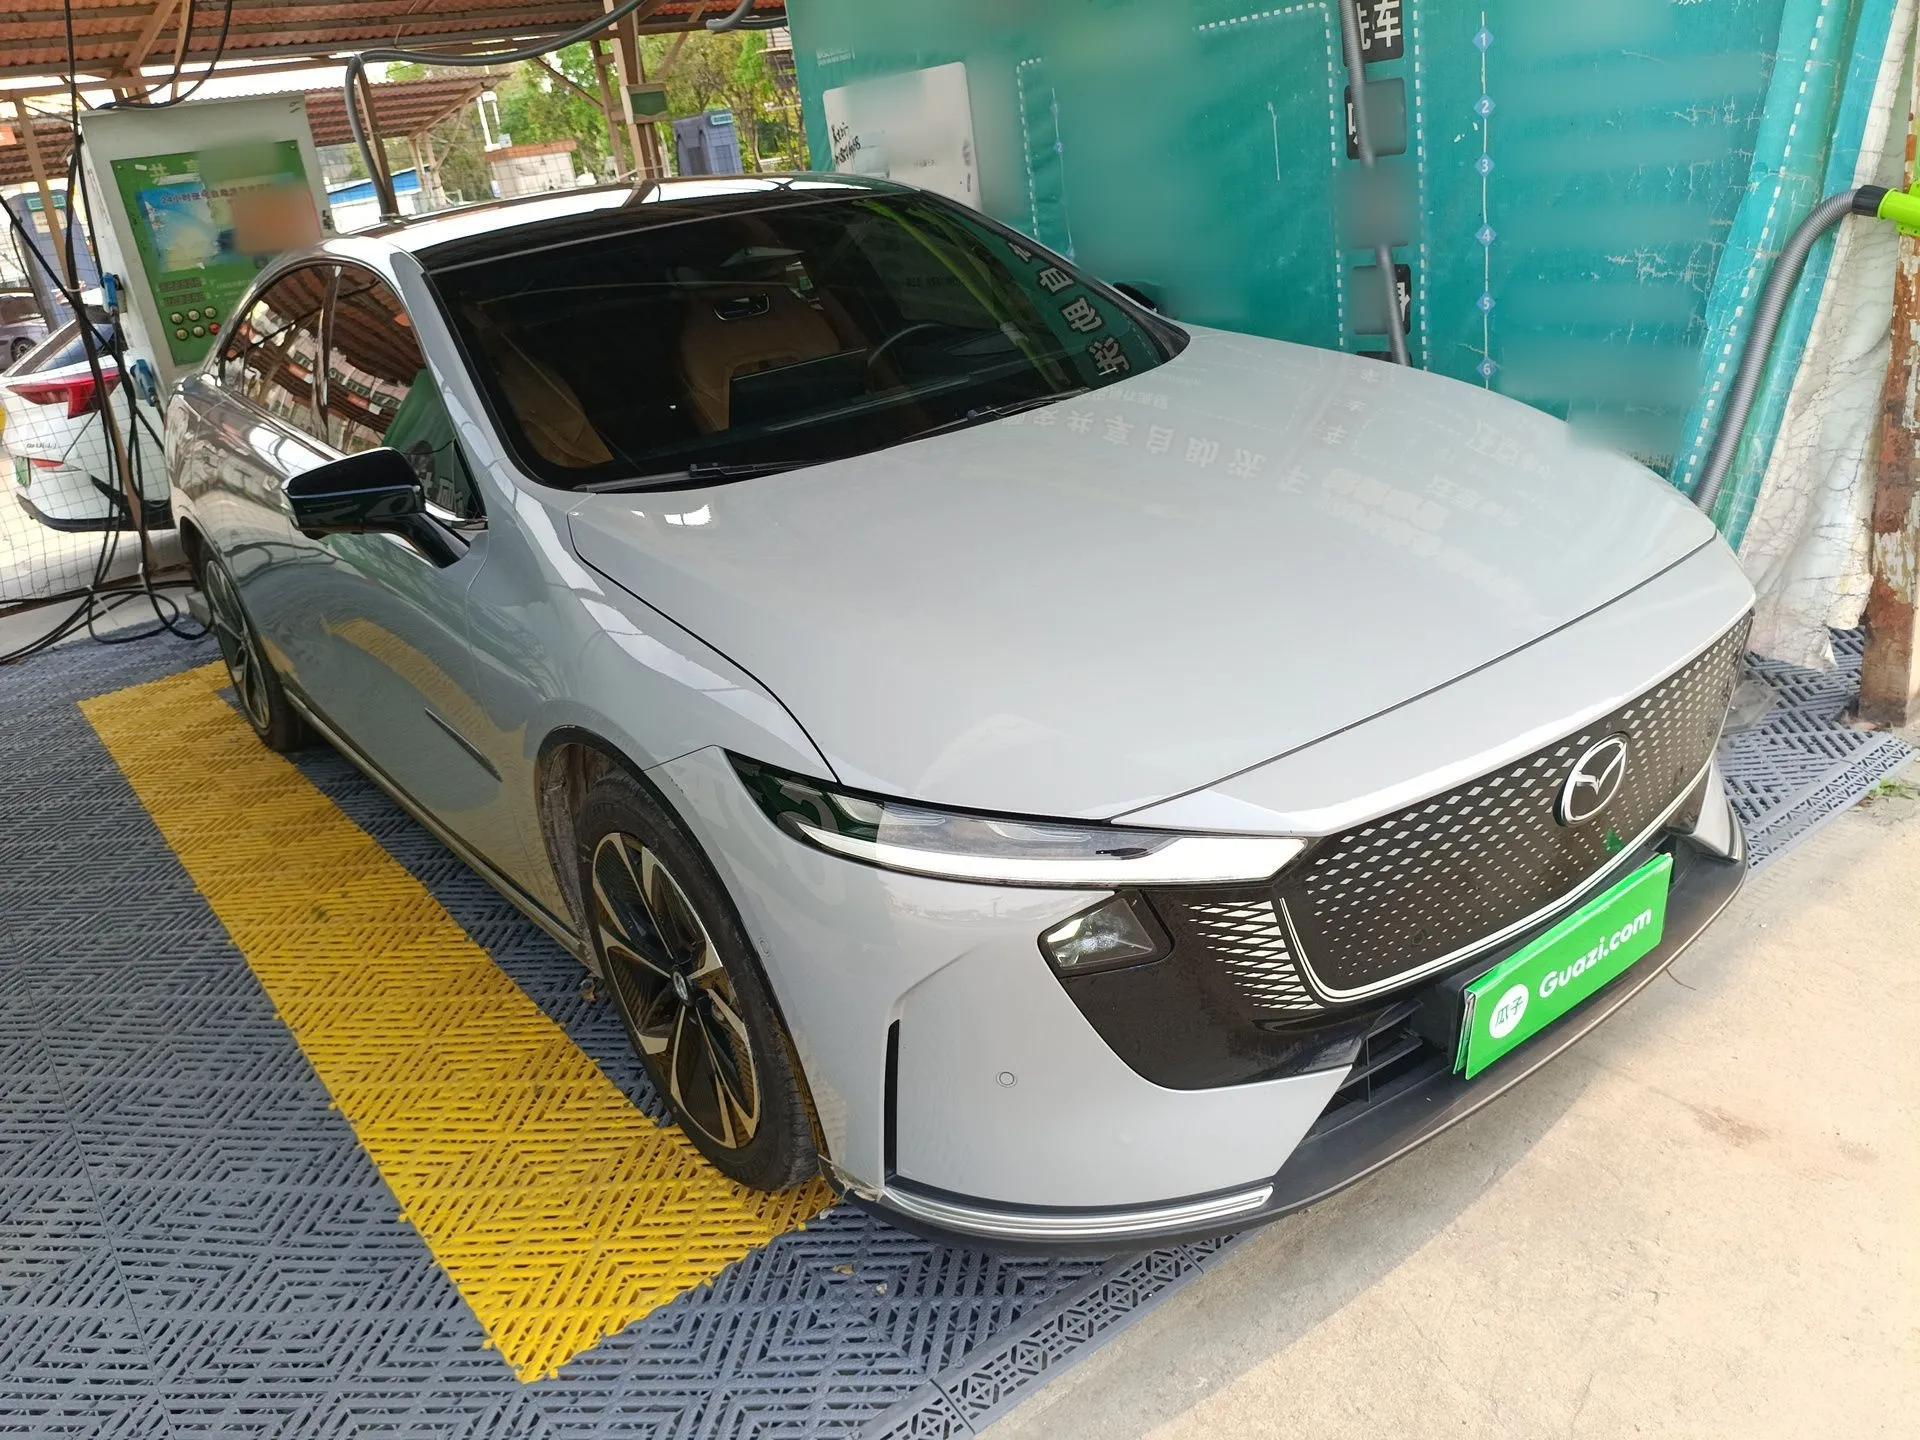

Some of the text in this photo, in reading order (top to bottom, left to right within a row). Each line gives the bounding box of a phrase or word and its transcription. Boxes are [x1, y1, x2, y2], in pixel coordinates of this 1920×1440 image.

[1480, 33, 1486, 46] 1
[1481, 100, 1489, 113] 2
[1481, 159, 1489, 172] 3
[1482, 228, 1490, 242] 4
[1483, 296, 1490, 310] 5
[1483, 362, 1491, 376] 6
[1539, 908, 1653, 999] Guazi.com
[1495, 995, 1524, 1027] 瓜子
